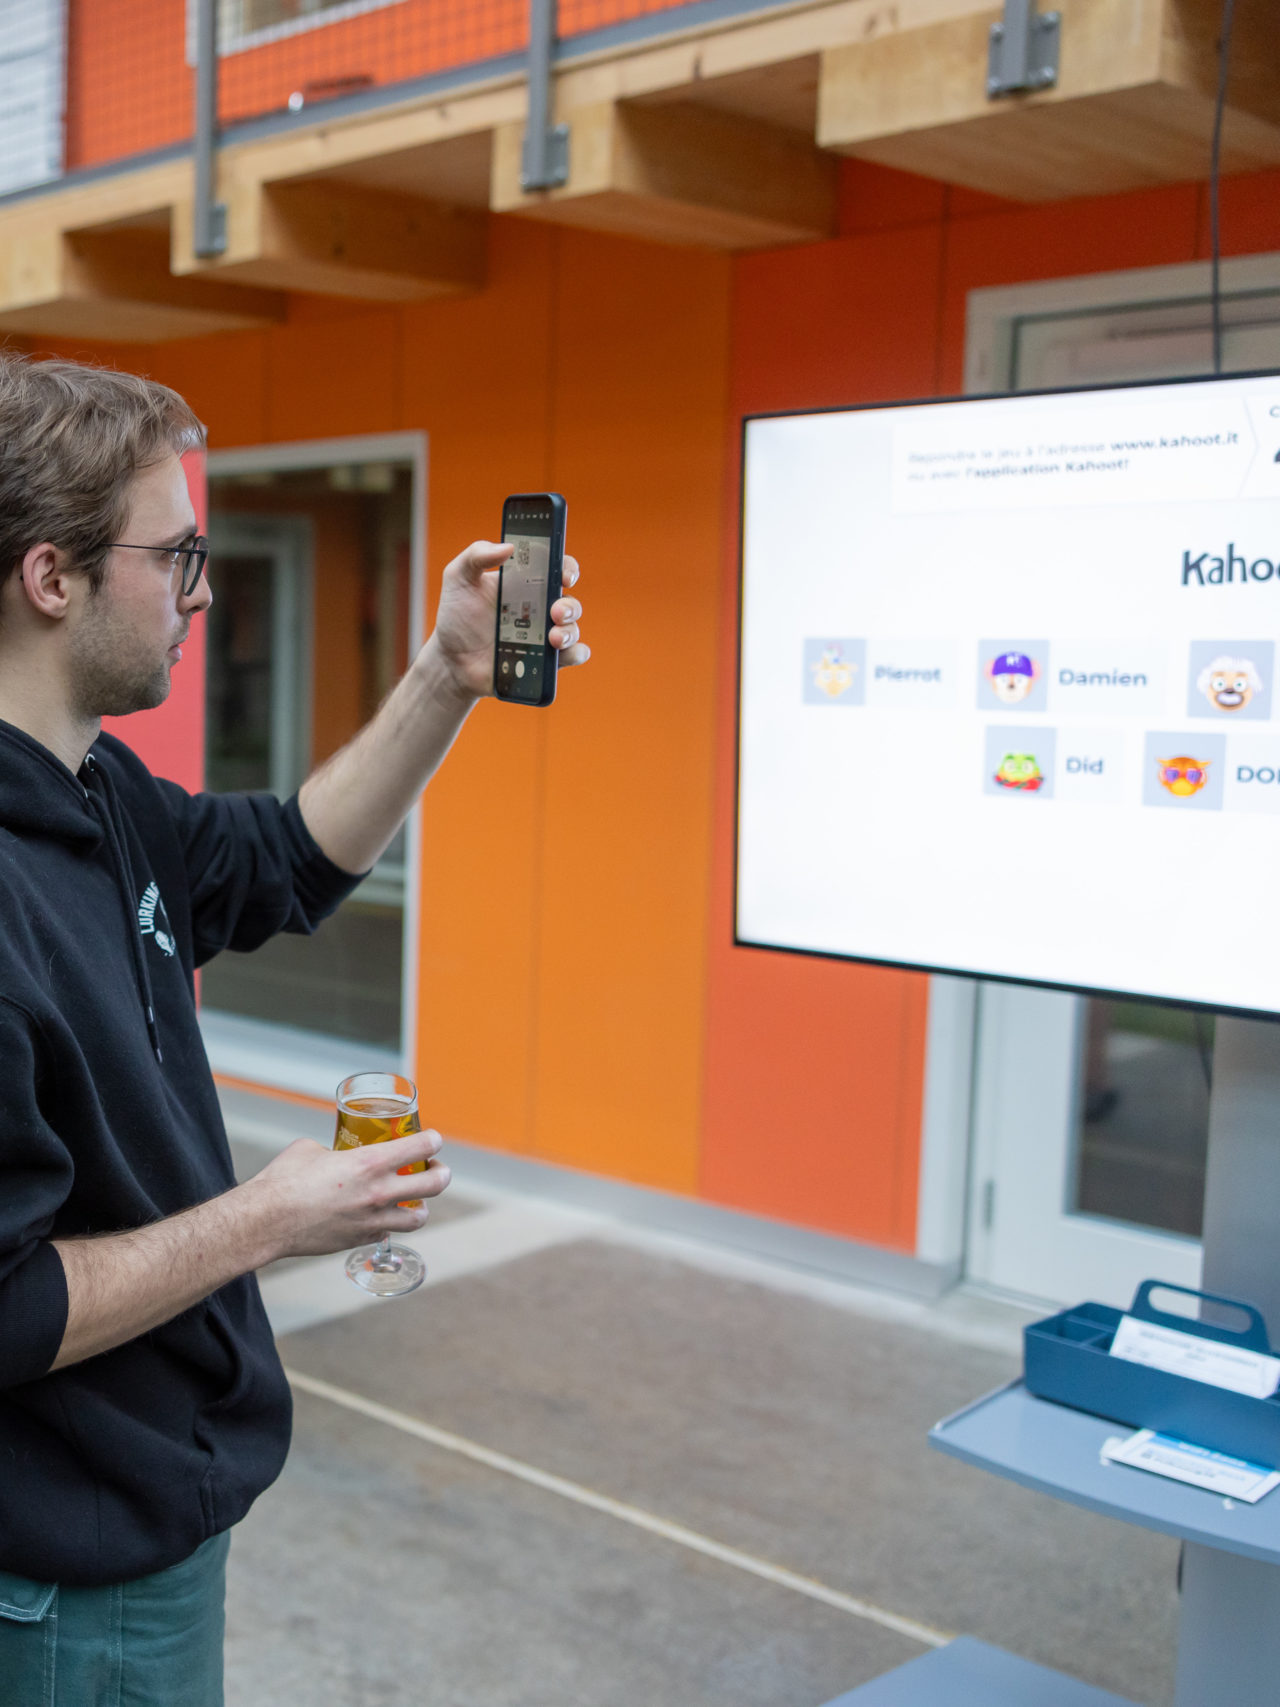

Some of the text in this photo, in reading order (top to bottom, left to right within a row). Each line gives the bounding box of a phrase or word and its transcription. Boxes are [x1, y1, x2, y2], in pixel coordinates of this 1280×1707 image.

[1110, 431, 1239, 451] www.kahoot.it
[966, 461, 1061, 478] l'application
[1065, 458, 1129, 473] Kahoot!
[1181, 542, 1280, 587] Kaho
[874, 665, 942, 683] Pierrot
[1058, 668, 1148, 687] Damien
[1065, 756, 1104, 775] Did
[1237, 765, 1280, 784] DO
